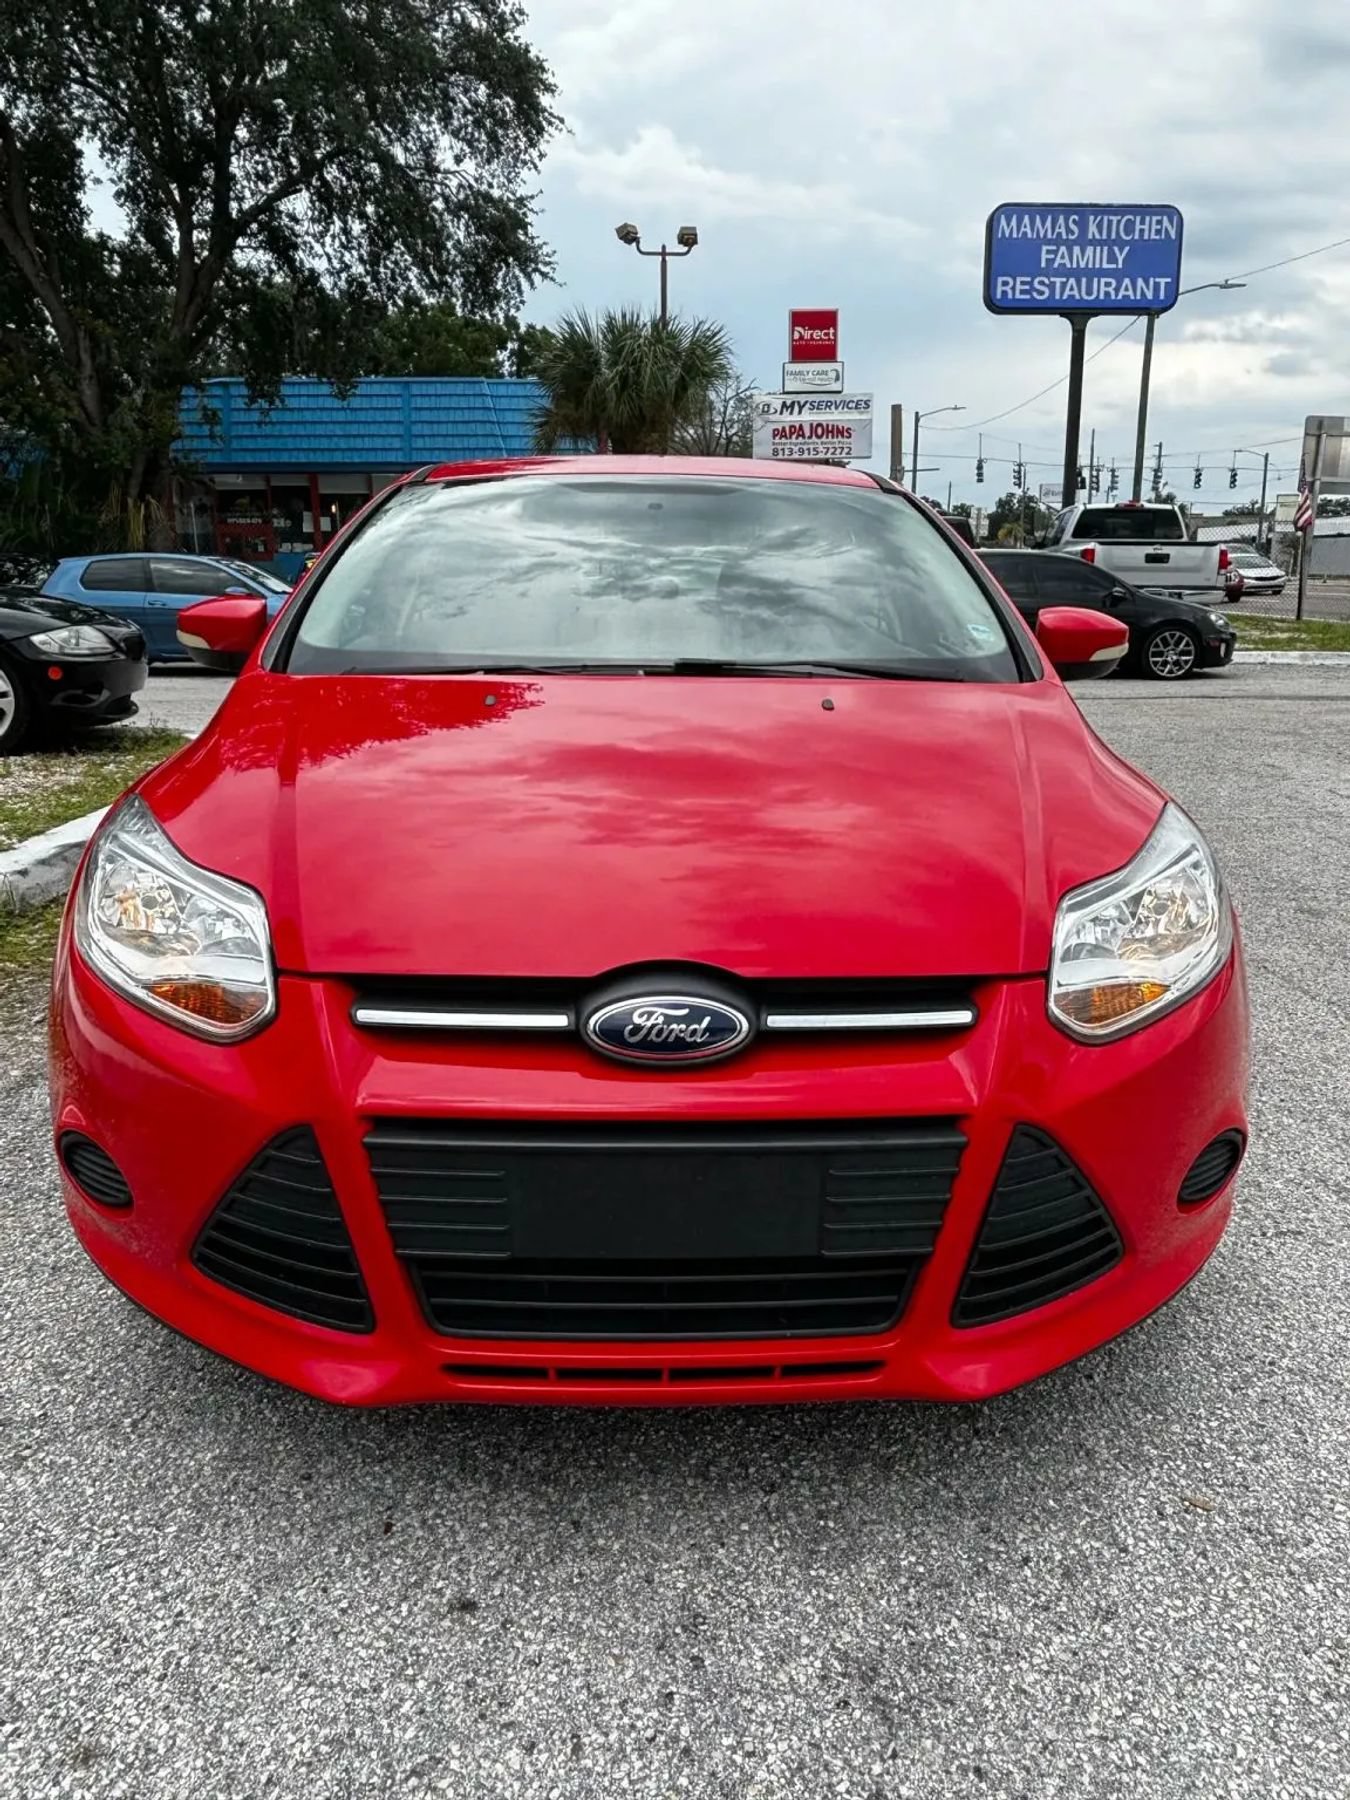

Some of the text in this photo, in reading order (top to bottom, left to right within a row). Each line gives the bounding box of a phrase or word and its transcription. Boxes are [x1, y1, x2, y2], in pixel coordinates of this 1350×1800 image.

[998, 214, 1177, 240] MAMAS KITCHEN
[1040, 245, 1130, 269] FAMILY
[996, 276, 1171, 300] RESTAURANT
[793, 326, 835, 340] Direct
[786, 369, 829, 377] FAMILY CARE
[772, 422, 852, 440] PAPA JOHNS
[772, 446, 852, 457] 813-915-7272
[623, 1006, 711, 1043] Ford
